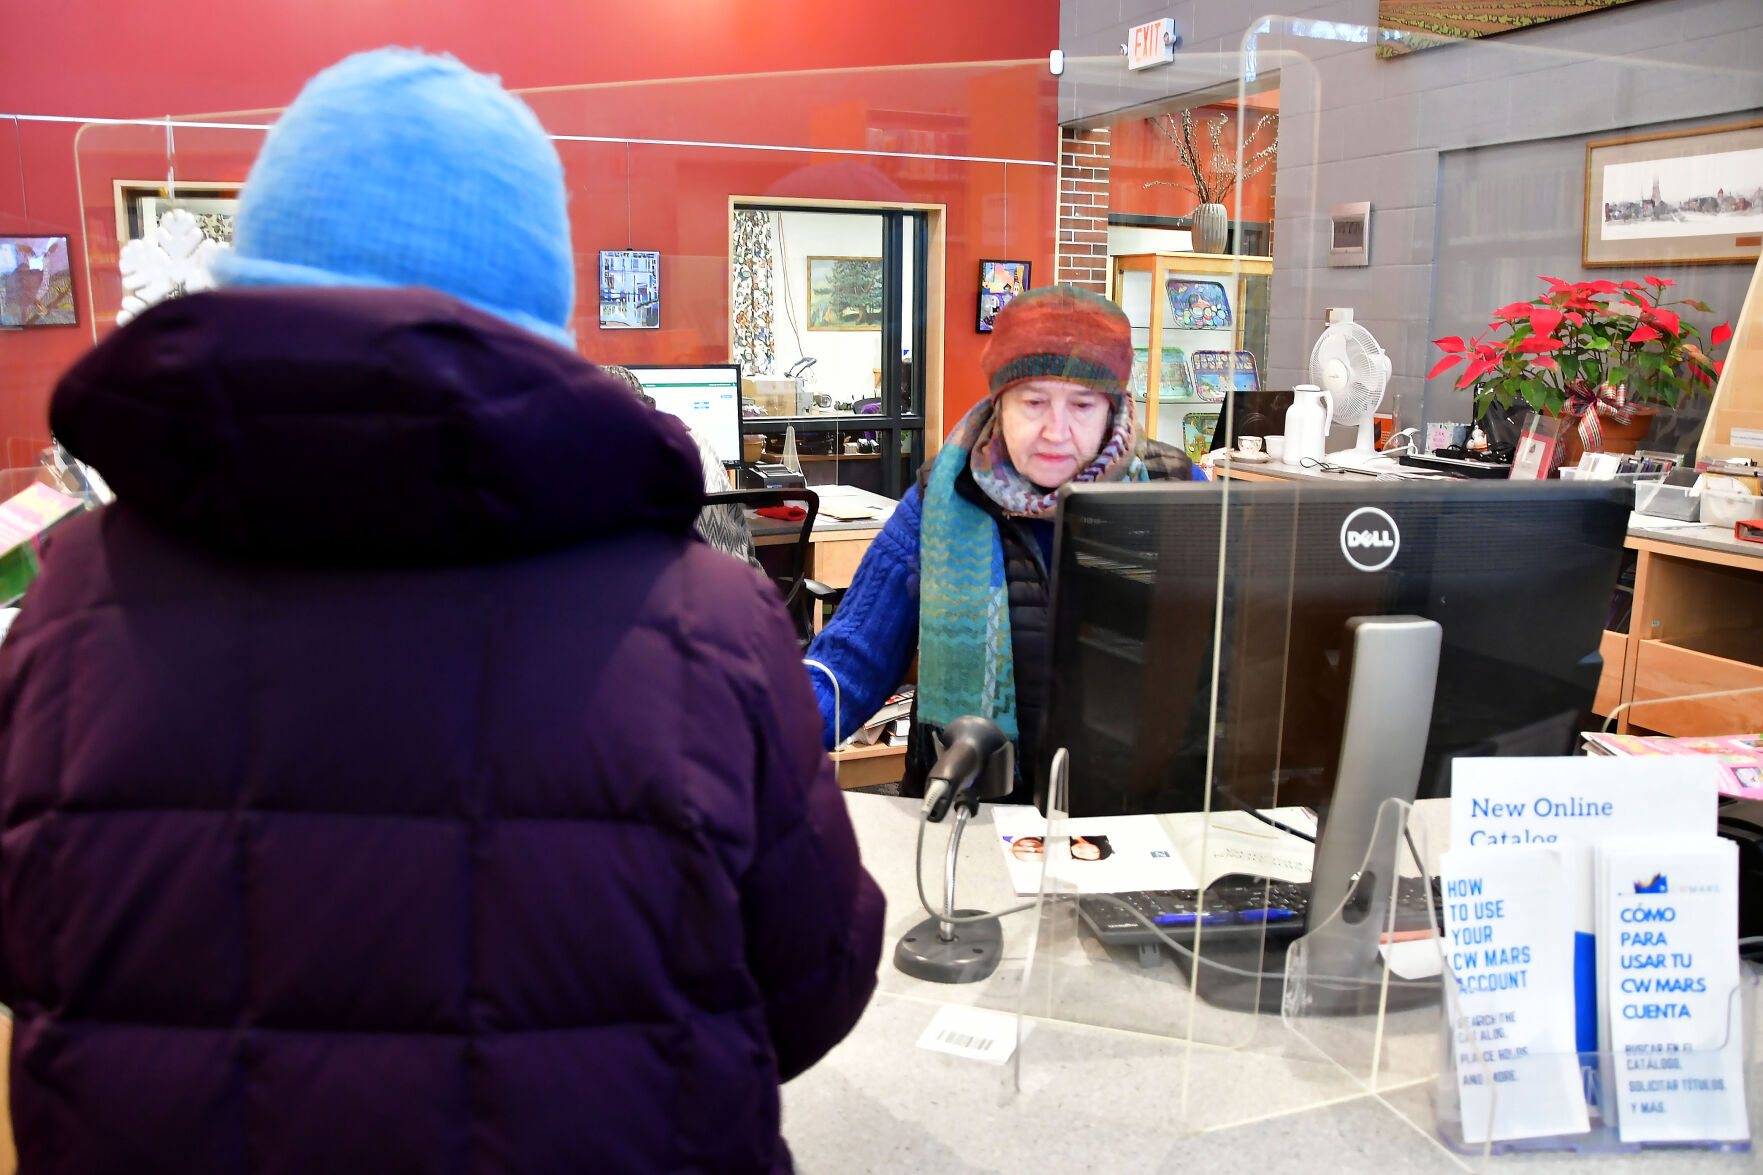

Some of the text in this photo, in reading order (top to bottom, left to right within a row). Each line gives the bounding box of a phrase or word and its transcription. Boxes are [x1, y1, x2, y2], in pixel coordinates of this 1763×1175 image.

[1135, 22, 1160, 57] EXIT
[1347, 530, 1394, 548] DELL
[1471, 796, 1613, 818] New Online
[1447, 878, 1483, 898] HOW
[1450, 899, 1504, 922] TO USE
[1620, 902, 1676, 923] CÓMO
[1451, 925, 1493, 946] YOUR
[1620, 931, 1668, 947] PARA
[1453, 946, 1531, 971] CW MARS
[1620, 953, 1692, 969] USAR TU
[1456, 969, 1528, 994] ACCOUNT
[1621, 977, 1707, 993] CW MARS
[1622, 1003, 1692, 1019] CUENTA
